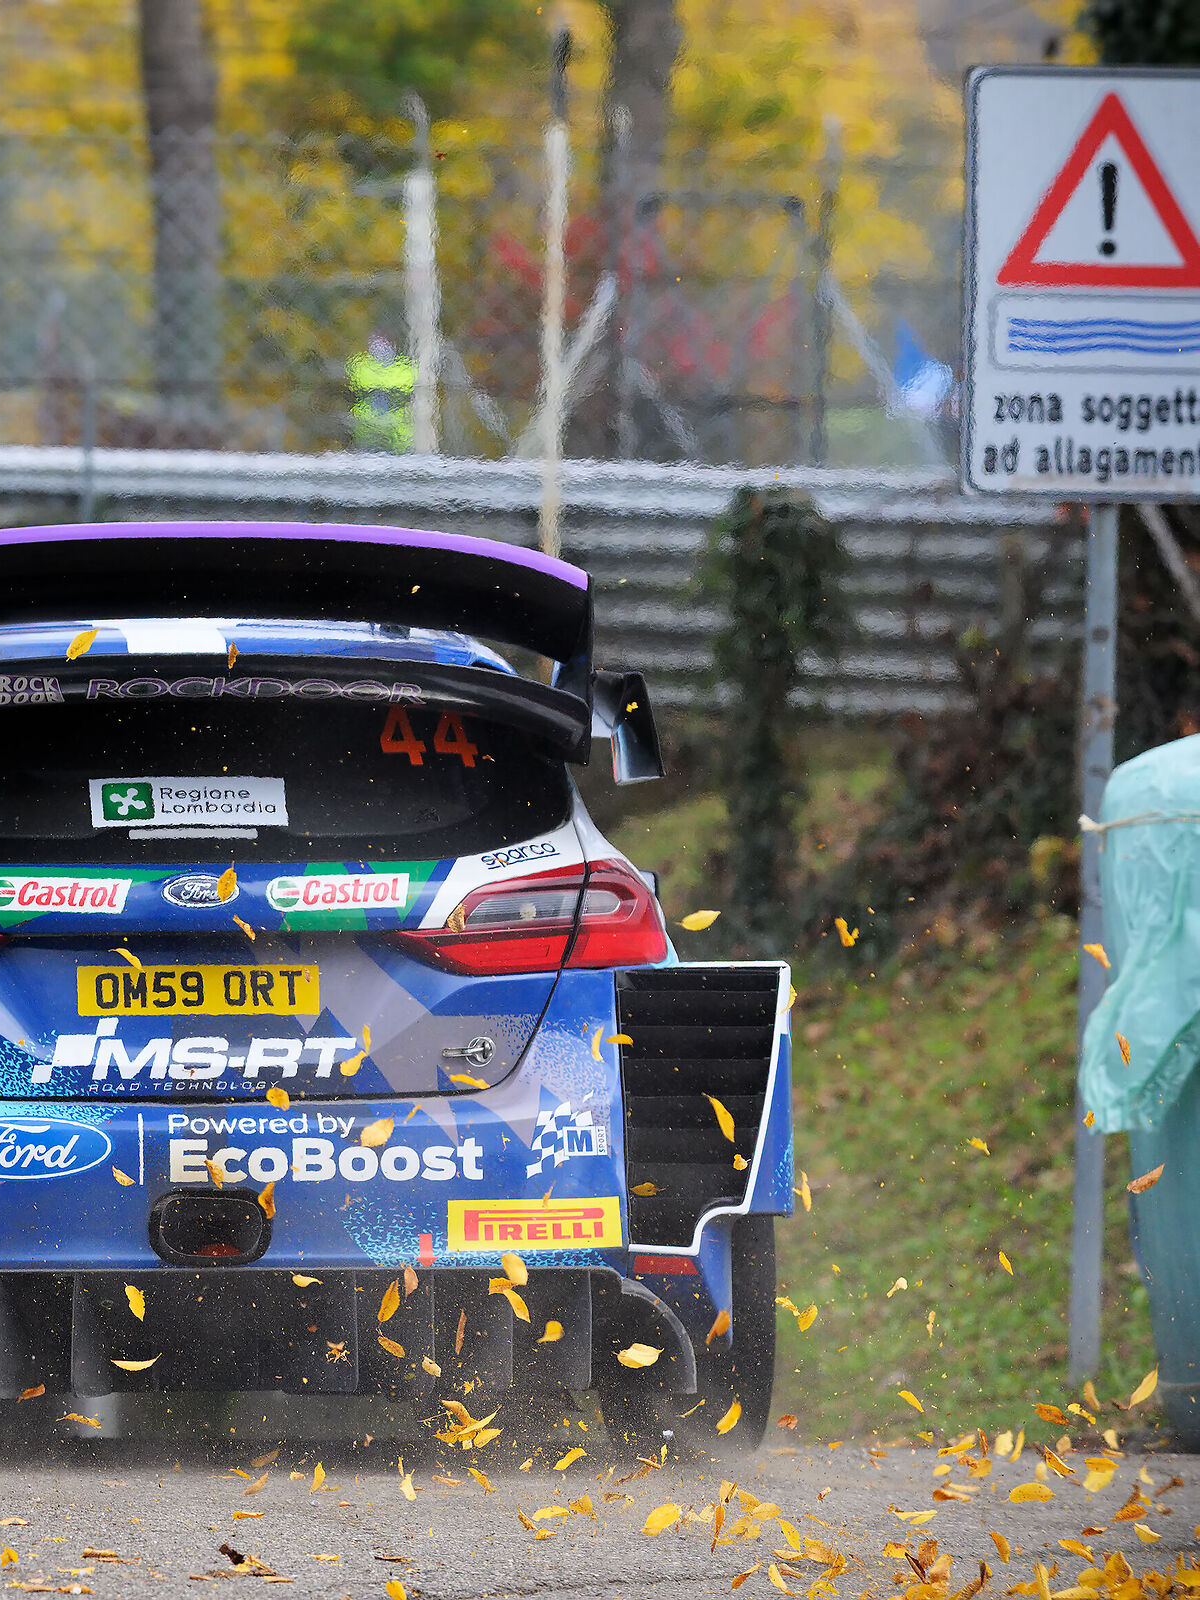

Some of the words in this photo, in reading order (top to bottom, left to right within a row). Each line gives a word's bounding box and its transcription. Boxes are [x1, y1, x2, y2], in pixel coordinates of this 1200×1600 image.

[994, 392, 1063, 424] zona
[984, 435, 1020, 474] ad
[1036, 436, 1200, 483] allagamen
[87, 677, 426, 704] ROCKDOOR
[380, 703, 478, 767] 44
[160, 786, 251, 802] Regione
[161, 801, 277, 814] Lombardia
[481, 842, 556, 868] sparco
[17, 881, 120, 907] Castrol
[301, 877, 400, 906] Castrol
[95, 970, 204, 1009] OM59
[223, 970, 303, 1007] ORT
[167, 1113, 309, 1135] Powered
[319, 1113, 356, 1139] by
[598, 1128, 606, 1153] SPORT
[169, 1137, 484, 1183] EcoBoost
[464, 1208, 605, 1241] PIRELLI
